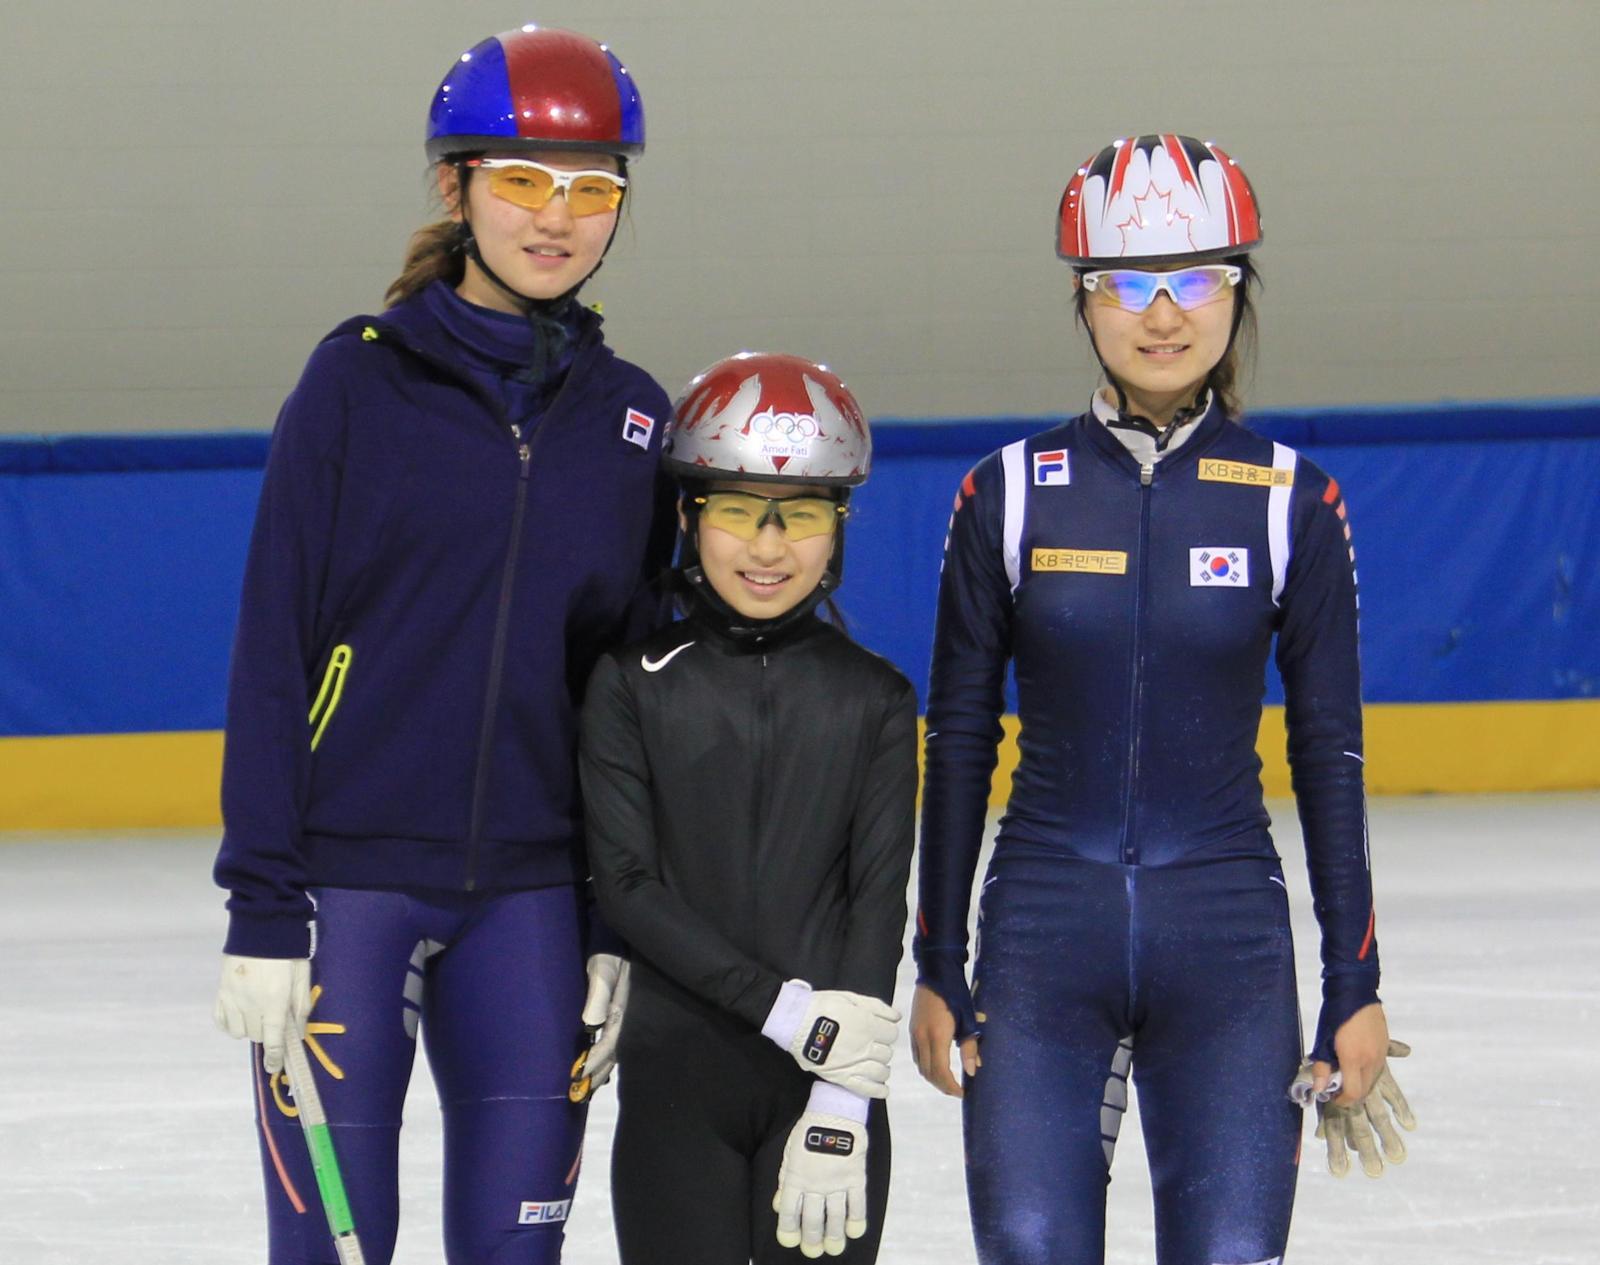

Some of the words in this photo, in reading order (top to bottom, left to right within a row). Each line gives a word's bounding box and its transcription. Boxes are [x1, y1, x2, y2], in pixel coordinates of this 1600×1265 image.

[761, 445, 788, 454] Amor
[791, 445, 808, 456] Fati
[525, 1204, 563, 1220] FILA
